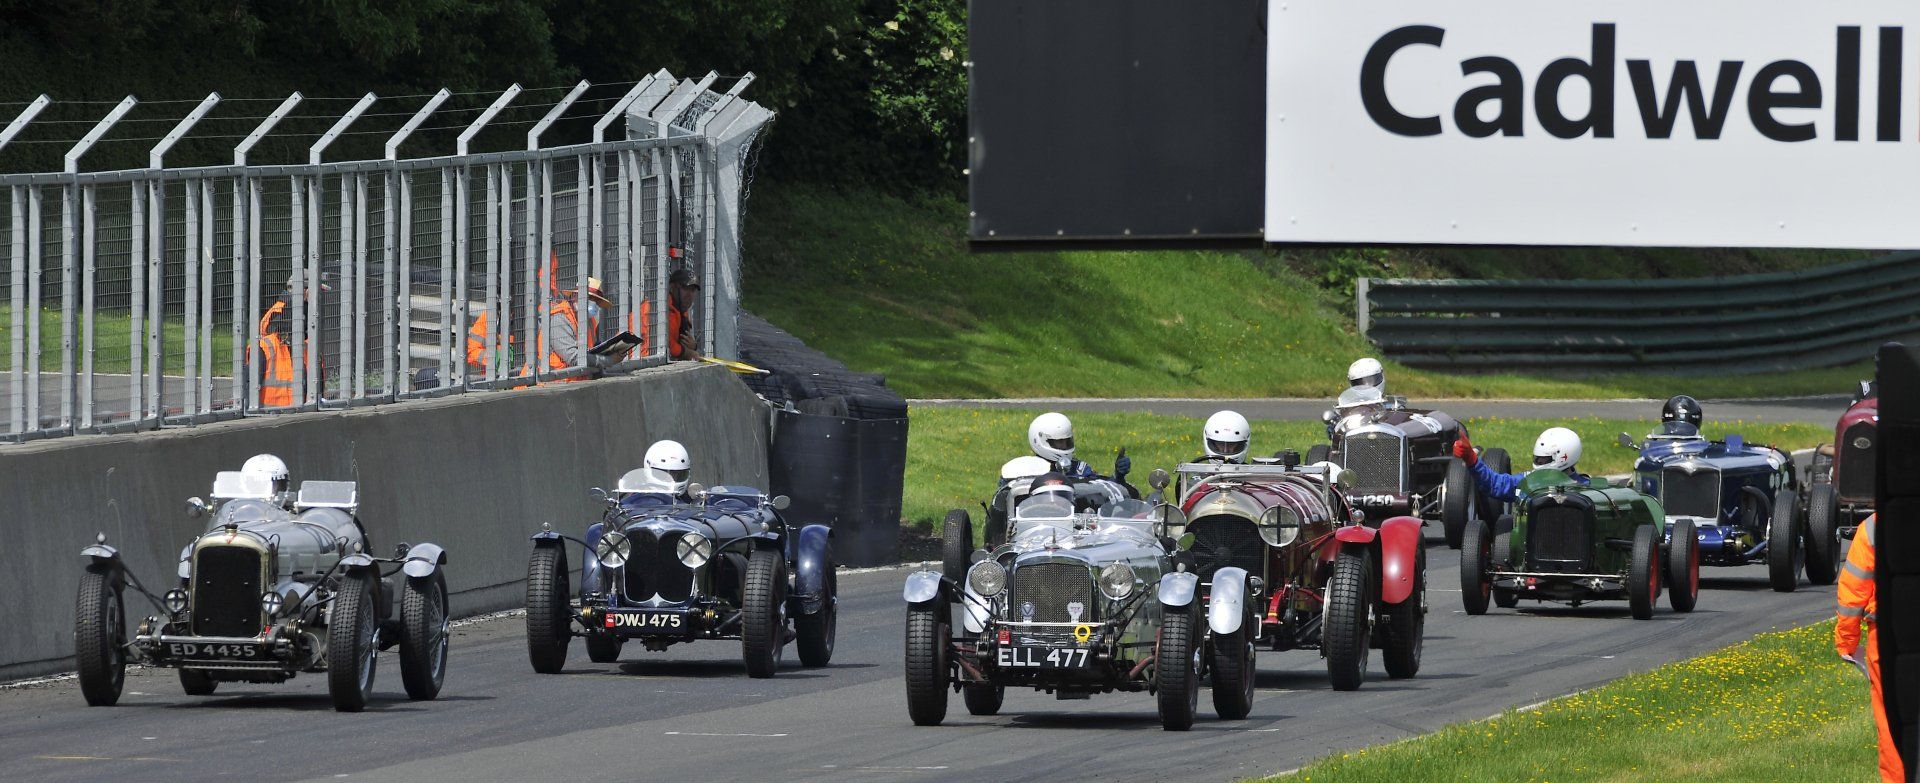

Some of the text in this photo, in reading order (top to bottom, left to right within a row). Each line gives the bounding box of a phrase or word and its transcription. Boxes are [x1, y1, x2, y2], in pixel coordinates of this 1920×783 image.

[1360, 22, 1903, 143] Cadwell
[615, 613, 681, 628] DWJ 475
[170, 643, 256, 657] ED 4435
[998, 647, 1089, 668] ELL 477
